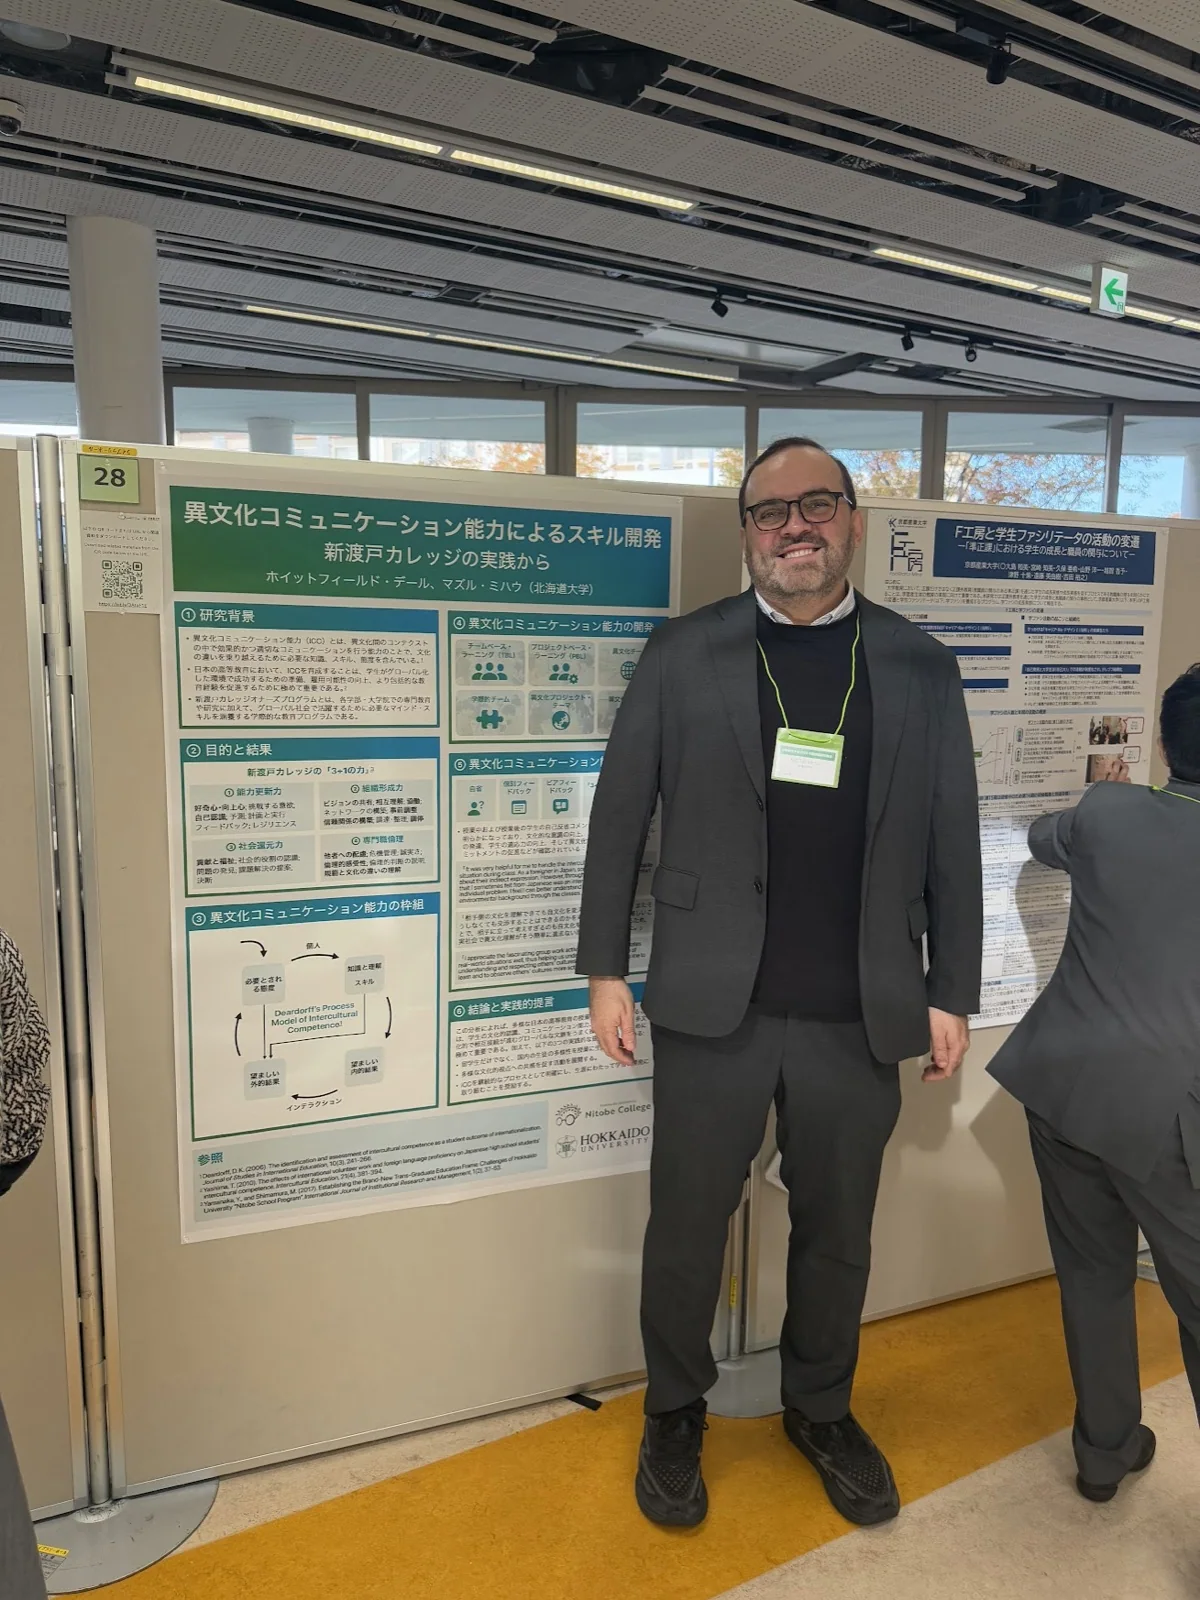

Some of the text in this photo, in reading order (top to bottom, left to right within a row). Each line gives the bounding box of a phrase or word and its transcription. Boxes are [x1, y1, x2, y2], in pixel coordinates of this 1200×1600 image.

[94, 467, 126, 488] 28
[184, 501, 661, 548] 異文化コミュニケーション能力によるスキル開発
[954, 526, 1140, 549] F工房と学生ファシリテータの活動の変遷
[324, 542, 550, 571] 新渡戸カレッジの実践から
[200, 608, 255, 623] 研究背景
[469, 617, 654, 633] 異文化コミュニケーション能力の開発
[206, 743, 273, 757] 目的と結果
[236, 787, 282, 797] 能力更新力
[362, 783, 404, 792] 組織形成力
[210, 899, 424, 924] 異文化コミュニケーション能力の枠組
[306, 942, 321, 950] 個人
[348, 962, 382, 972] 知識と理解
[245, 976, 282, 986] 必要とされ
[355, 978, 374, 986] スキル
[253, 984, 276, 993] る態度
[275, 1002, 355, 1017] Deardorff's Process
[467, 996, 555, 1016] 結論と実践的提言
[271, 1011, 358, 1027] Model of Intercultural
[351, 1059, 379, 1067] 望ましい
[250, 1070, 280, 1079] 望ましい
[350, 1066, 378, 1076] 内的結果
[250, 1078, 280, 1088] 外的結果
[286, 1099, 342, 1112] インタラクション
[585, 1109, 616, 1119] Nitobe
[617, 1102, 651, 1114] College
[580, 1126, 650, 1145] HOKKAIDO
[580, 1137, 649, 1153] UNIVERSITY
[197, 1152, 224, 1166] 参照
